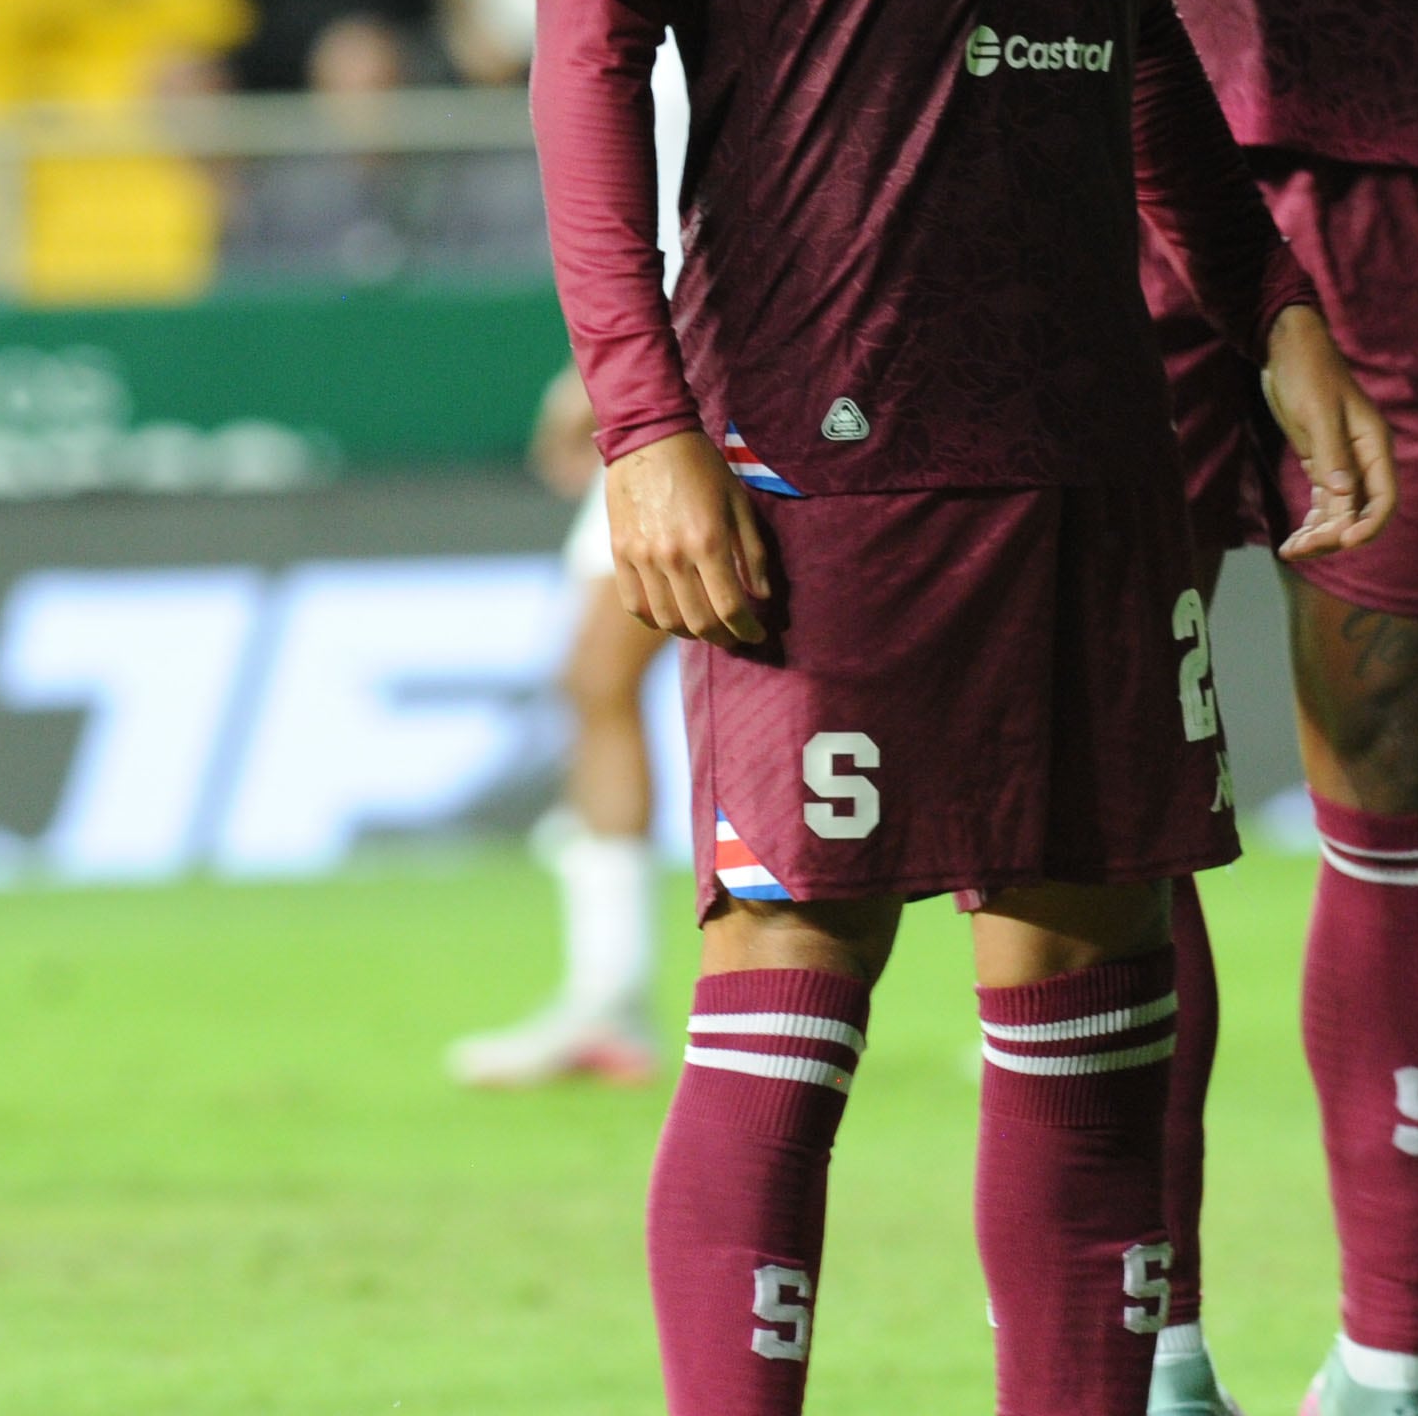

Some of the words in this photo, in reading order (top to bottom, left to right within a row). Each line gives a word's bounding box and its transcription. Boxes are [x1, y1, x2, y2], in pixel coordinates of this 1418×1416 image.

[1004, 35, 1114, 73] Castrol
[1171, 588, 1218, 742] 2
[802, 731, 880, 839] S
[750, 1263, 812, 1361] S
[1123, 1241, 1173, 1334] S
